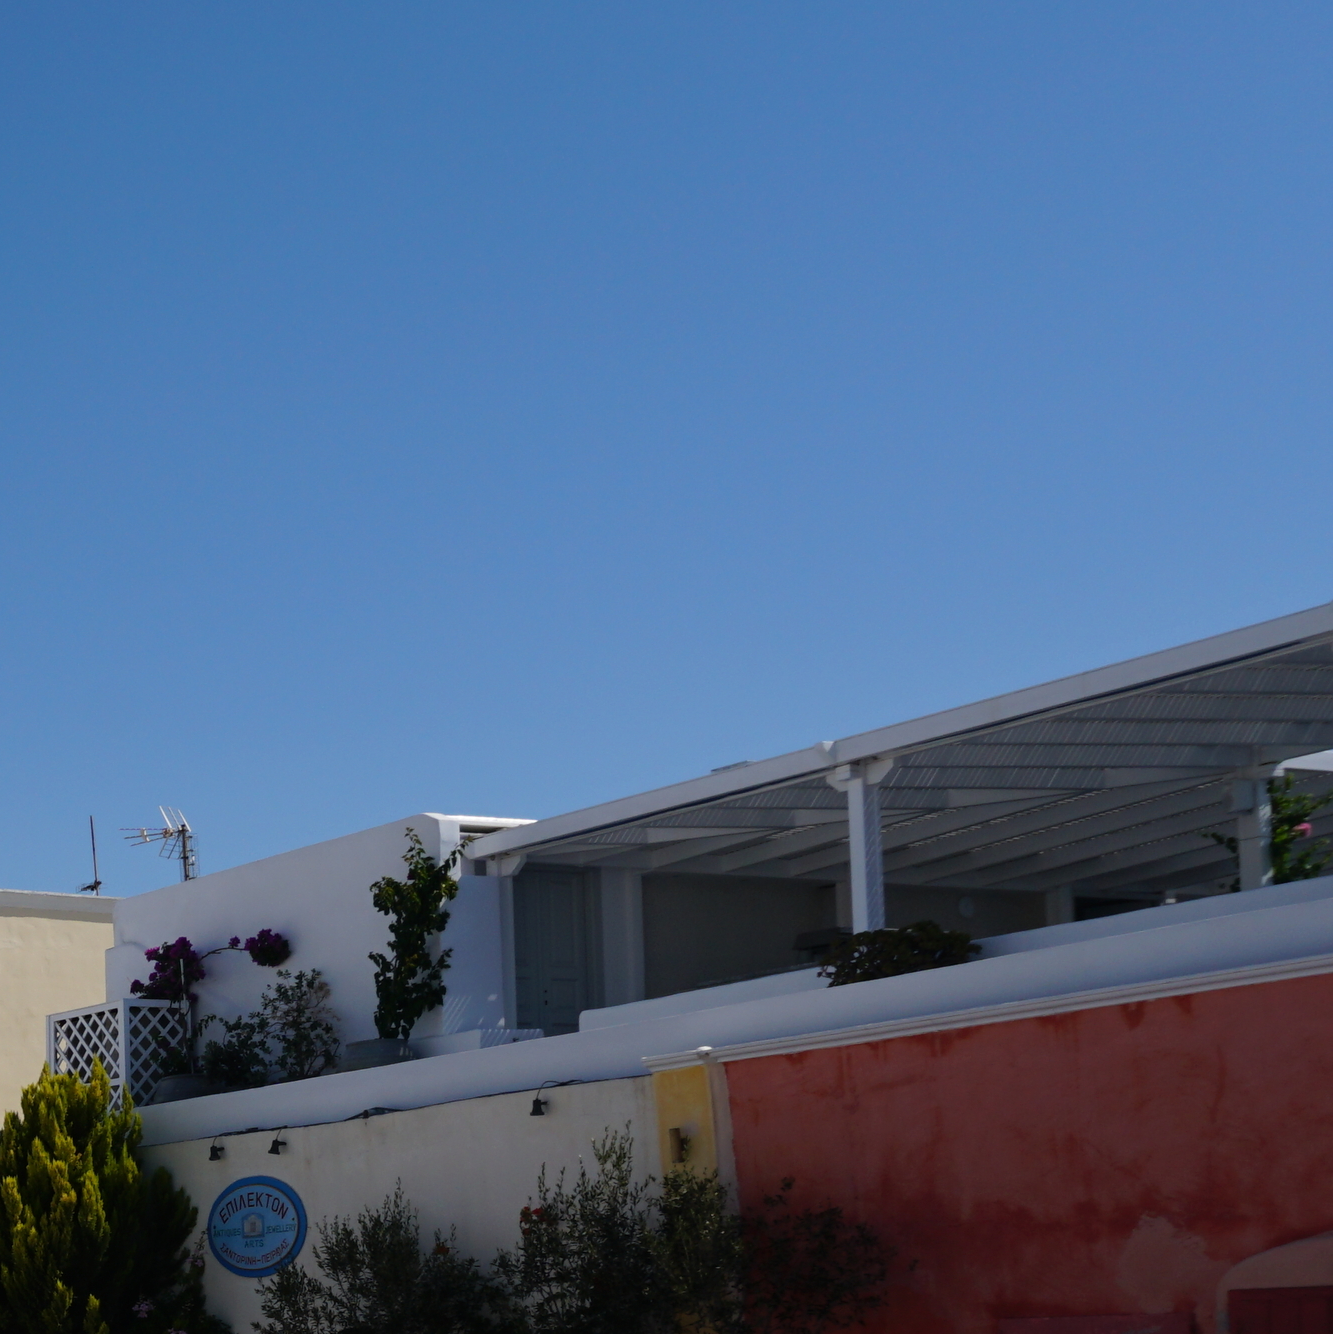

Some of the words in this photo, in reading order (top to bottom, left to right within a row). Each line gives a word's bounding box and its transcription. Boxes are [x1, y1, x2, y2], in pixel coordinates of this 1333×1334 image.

[219, 1192, 289, 1224] ΕΠΙΛΕΚΤΟΝ
[213, 1228, 241, 1237] ANTIQUES
[265, 1224, 296, 1235] JEWELLERY
[244, 1239, 264, 1248] ARTS
